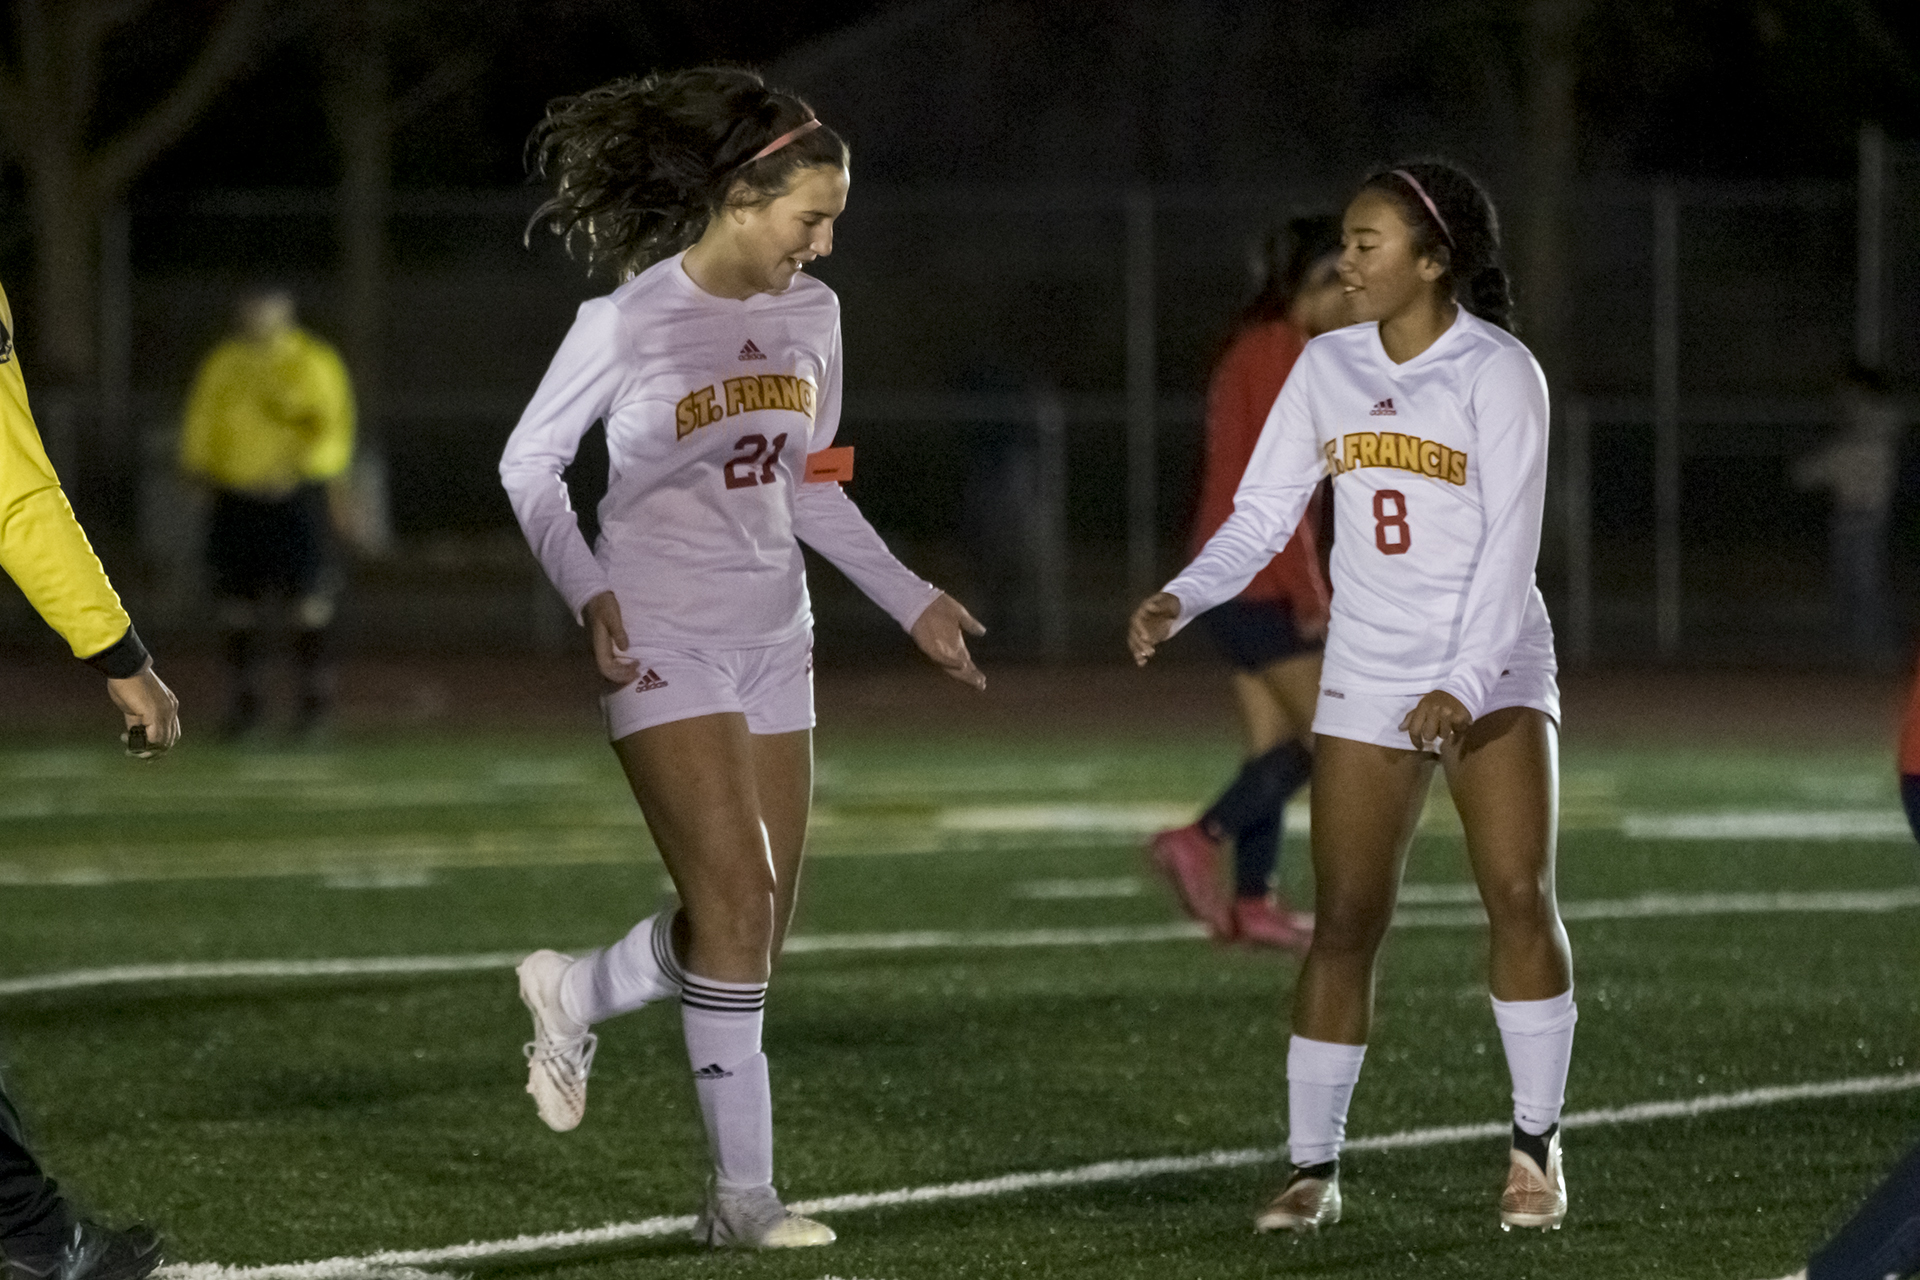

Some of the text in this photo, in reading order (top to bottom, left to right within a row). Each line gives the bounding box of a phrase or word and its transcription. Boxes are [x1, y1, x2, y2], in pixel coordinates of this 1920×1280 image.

[676, 374, 815, 441] ST. FRANC
[723, 432, 788, 490] 21
[1343, 431, 1468, 486] FRANCIS
[1372, 489, 1411, 556] 8
